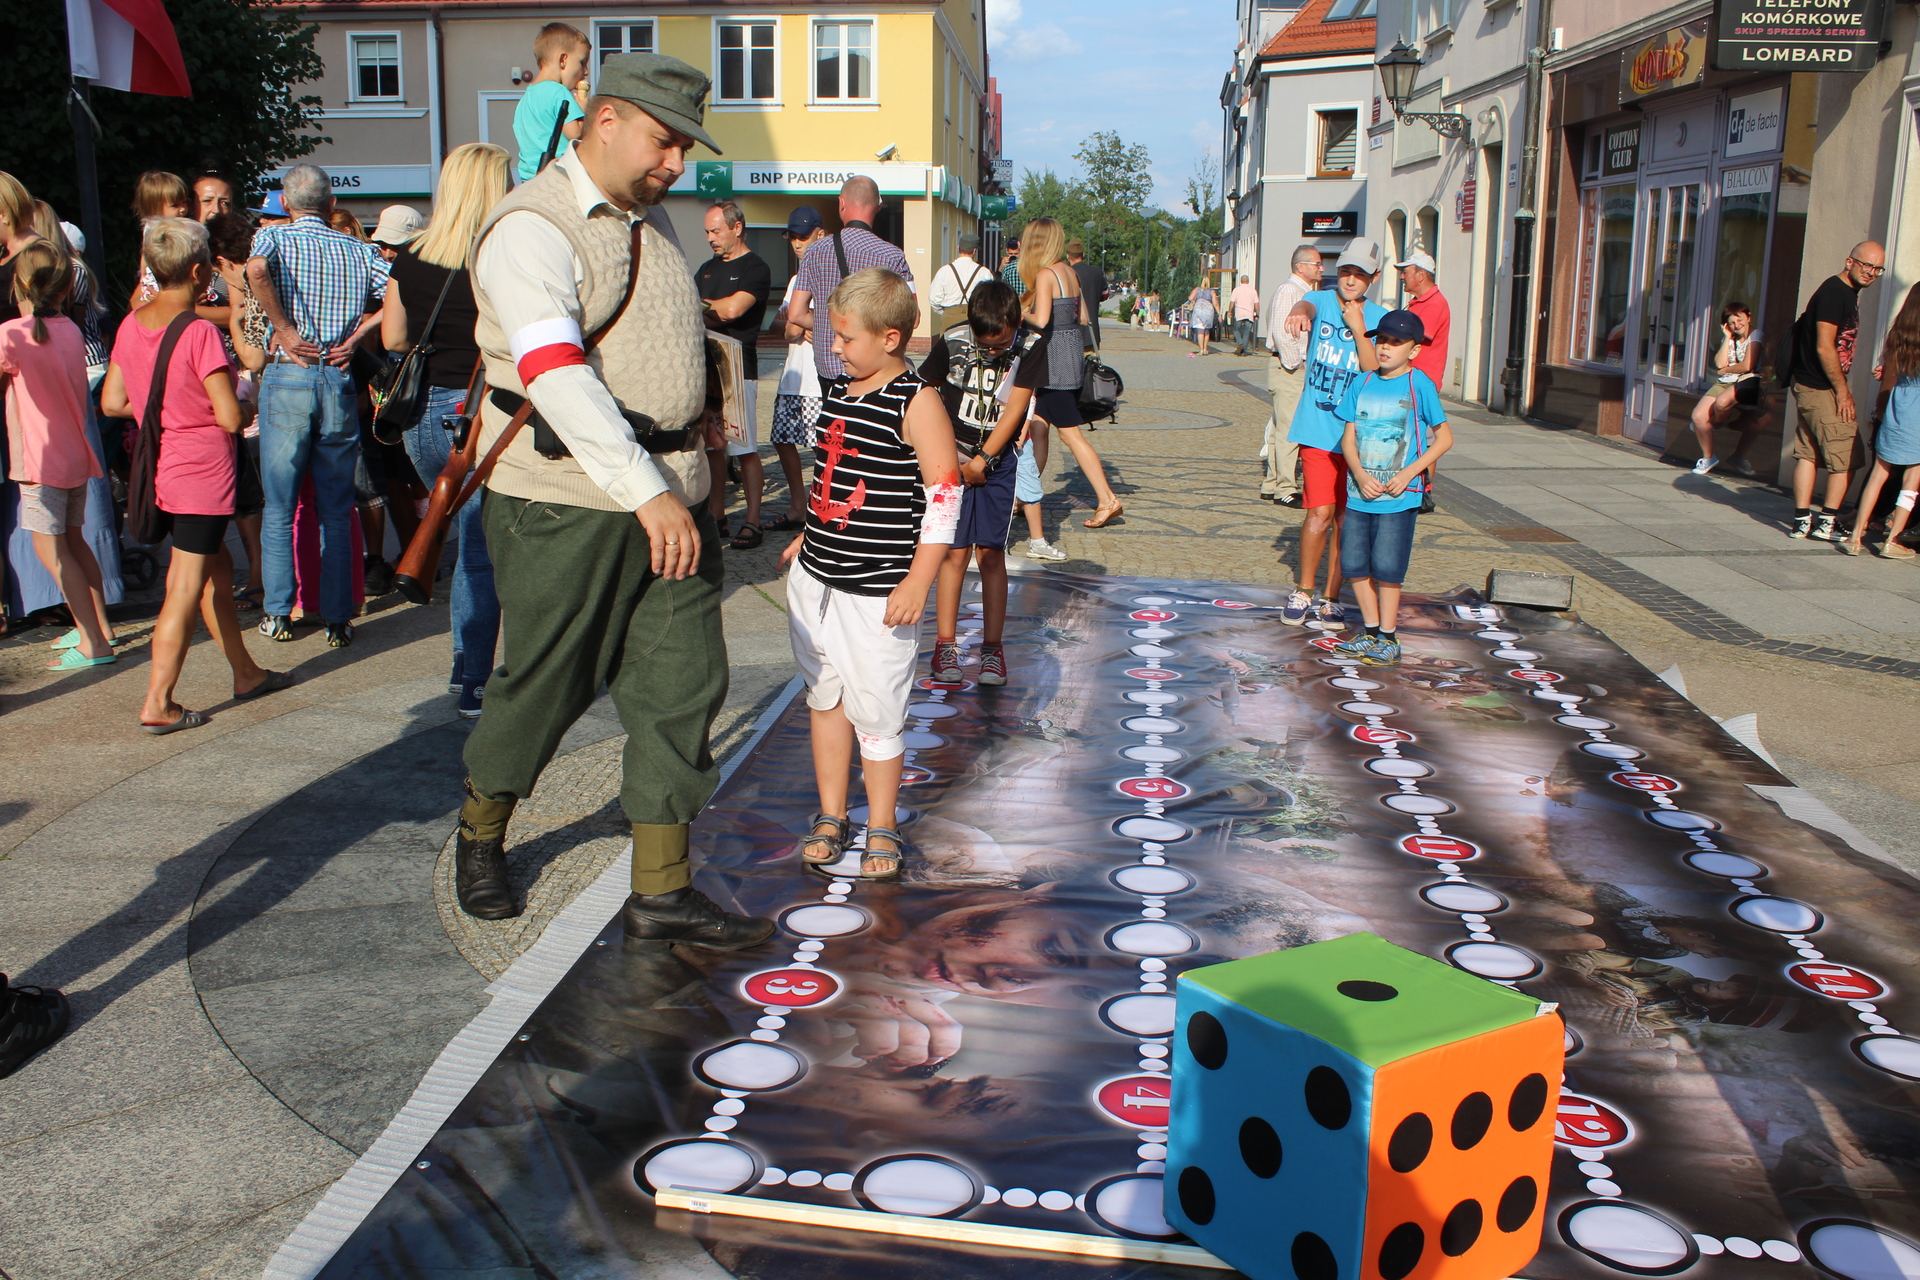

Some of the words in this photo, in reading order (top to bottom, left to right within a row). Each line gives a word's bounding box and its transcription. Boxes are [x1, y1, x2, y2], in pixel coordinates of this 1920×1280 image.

[1740, 9, 1863, 25] KOMÓRKOWE
[1734, 27, 1765, 35] SKUP
[1767, 26, 1822, 36] SPRZEDAŻ
[1824, 28, 1866, 36] SERWIS
[1742, 47, 1853, 62] LOMBARD
[1745, 115, 1756, 133] de
[1757, 112, 1778, 131] facto
[1608, 128, 1639, 150] COTTON
[1611, 149, 1632, 168] CLUB
[331, 175, 361, 187] BAS
[750, 172, 783, 184] BNP
[1726, 166, 1770, 189] BIALCON
[967, 366, 996, 392] AC
[1518, 669, 1552, 681] 16
[1134, 781, 1173, 794] 5
[1622, 773, 1669, 791] 15
[1413, 836, 1462, 856] 11
[764, 977, 819, 997] 3
[1799, 965, 1870, 995] 14
[1123, 1085, 1171, 1110] 4
[1555, 1103, 1611, 1142] 12
